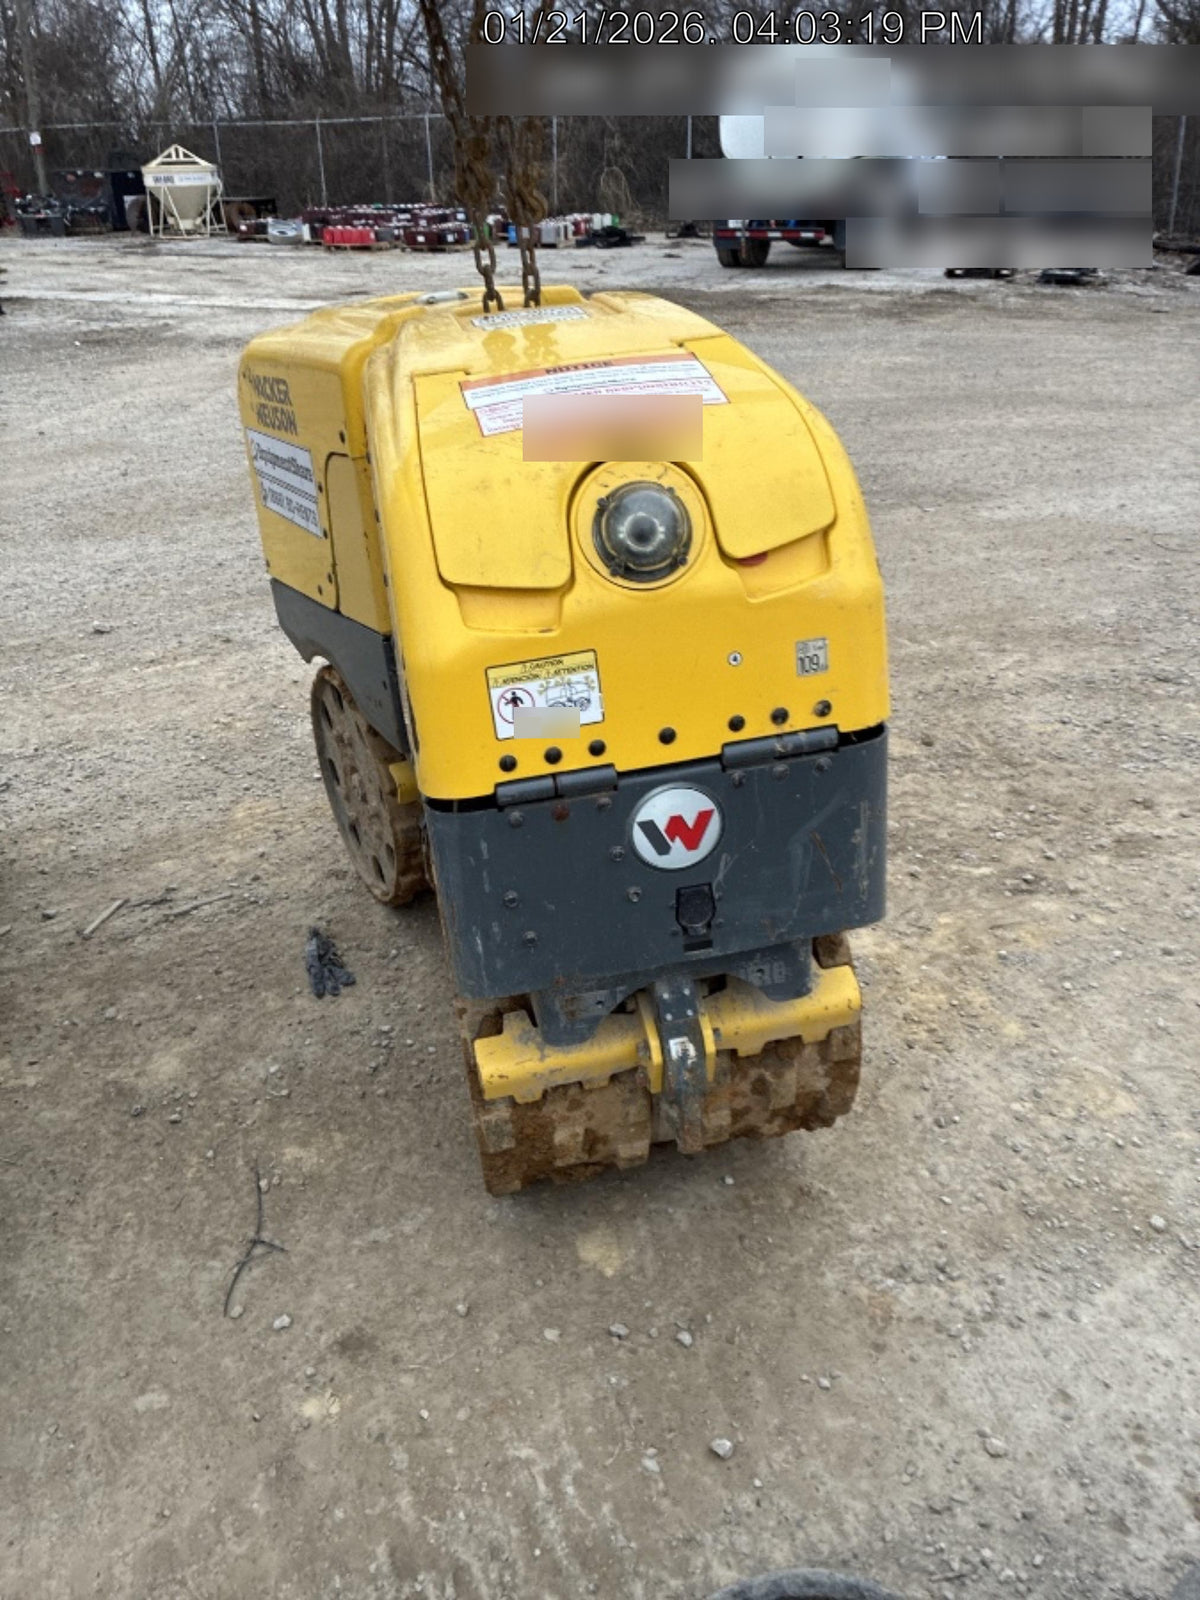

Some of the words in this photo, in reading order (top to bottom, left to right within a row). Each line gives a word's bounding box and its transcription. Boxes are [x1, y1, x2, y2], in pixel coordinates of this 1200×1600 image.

[545, 360, 613, 375] NOTICE
[248, 372, 293, 407] WACKER
[253, 402, 298, 436] NEUSON
[529, 658, 564, 671] CAUTION
[554, 664, 594, 675] ATTENTION
